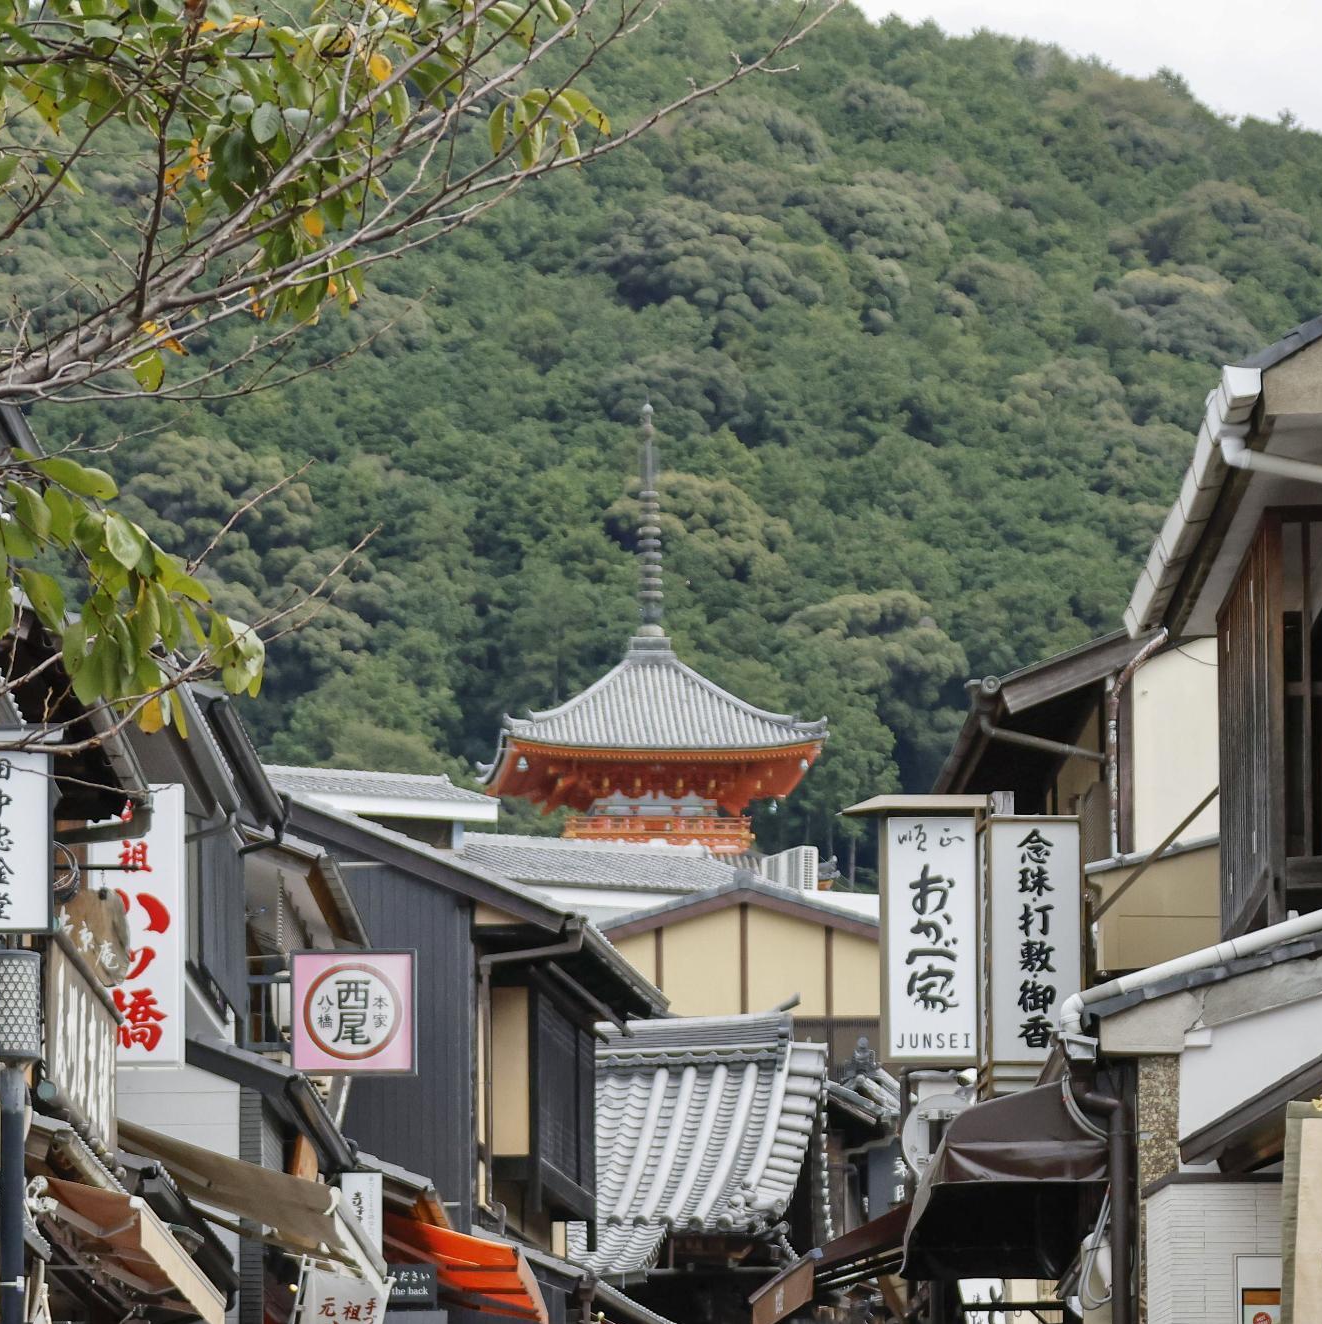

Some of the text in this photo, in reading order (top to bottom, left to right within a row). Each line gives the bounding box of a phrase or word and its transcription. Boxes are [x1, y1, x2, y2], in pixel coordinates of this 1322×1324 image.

[332, 979, 372, 1045] 西尾
[372, 995, 389, 1029] 本家
[896, 1032, 971, 1050] JUNSEI
[391, 1285, 429, 1295] the back
